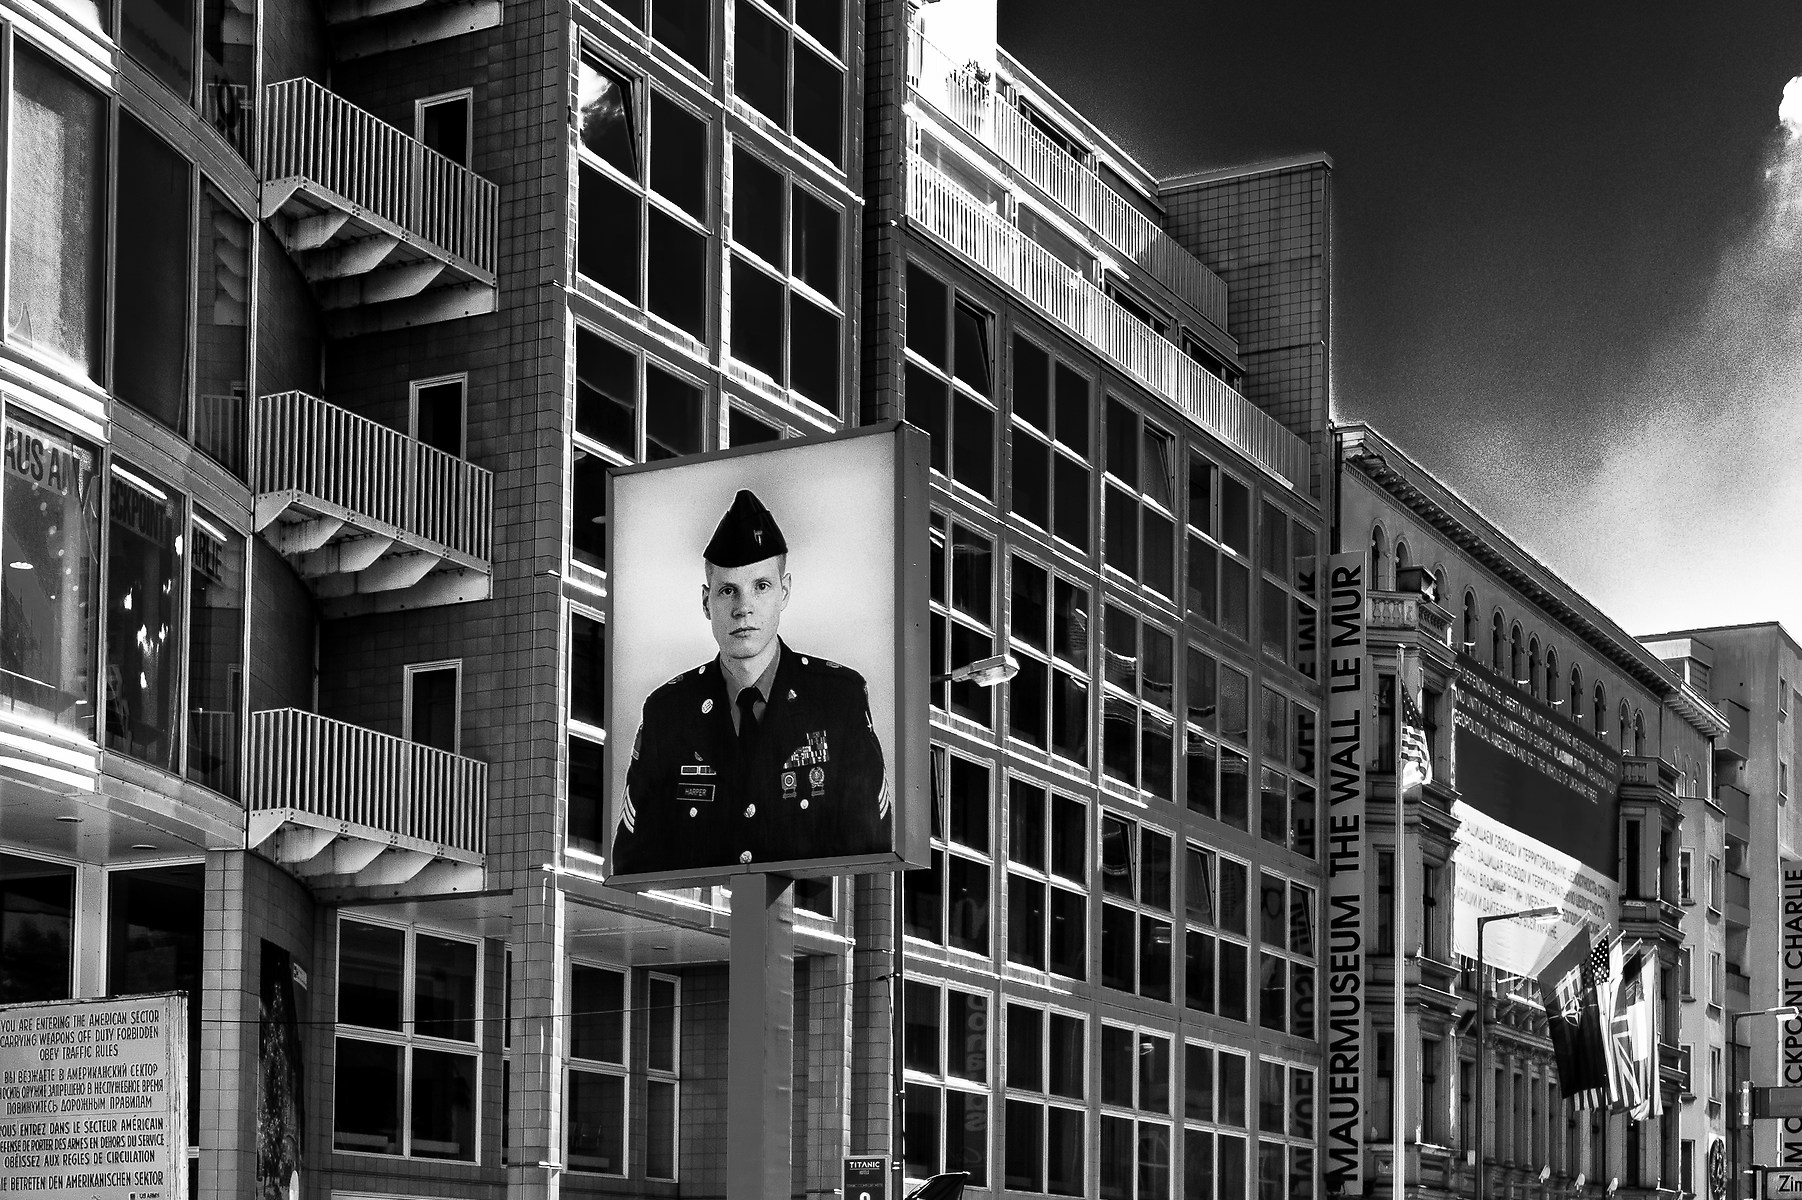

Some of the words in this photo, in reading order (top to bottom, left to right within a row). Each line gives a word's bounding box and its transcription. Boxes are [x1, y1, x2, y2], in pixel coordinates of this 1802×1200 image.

[1331, 565, 1362, 648] MUR
[1331, 657, 1361, 693] LE
[1330, 709, 1361, 806] WALL
[1330, 814, 1360, 877] THE
[1, 1019, 15, 1033] YOU
[19, 1018, 33, 1031] ARE
[36, 1015, 70, 1030] ENTERING
[73, 1014, 85, 1027] THE
[89, 1011, 127, 1027] AMERICAN
[131, 1009, 159, 1024] SECTOR
[0, 1033, 36, 1048] CARRYING
[39, 1031, 74, 1045] WEAPONS
[78, 1030, 91, 1043] OFF
[96, 1028, 114, 1042] DUTY
[117, 1026, 158, 1040] FORBIDDEN
[1329, 894, 1361, 1181] MAUERMUSEUM
[40, 1048, 59, 1061] OBEY
[63, 1046, 92, 1059] TRAFFIC
[96, 1044, 118, 1057] RULES
[4, 1071, 16, 1084] ВЫ
[59, 1068, 64, 1081] В
[67, 1063, 127, 1080] АМЕРИКАНСКИЙ
[131, 1063, 158, 1077] СЕКТОР
[88, 1081, 92, 1094] В
[143, 1079, 163, 1092] ВРЕМЯ
[110, 1096, 152, 1109] ПРАВИЛАМ
[20, 1123, 46, 1136] ENTREZ
[50, 1122, 70, 1135] DANS
[73, 1121, 80, 1133] LE
[84, 1119, 117, 1133] SECTEUR
[121, 1115, 163, 1131] AMÉRICAIN
[23, 1140, 30, 1152] DE
[31, 1139, 53, 1151] PORTER
[55, 1138, 66, 1150] DES
[67, 1137, 88, 1149] ARMES
[90, 1137, 98, 1148] EN
[100, 1135, 125, 1148] DEHORS
[127, 1135, 137, 1147] DU
[138, 1133, 165, 1146] SERVICE
[4, 1152, 40, 1168] OBÉISSEZ
[44, 1154, 60, 1167] AUX
[63, 1153, 89, 1166] REGLES
[94, 1152, 102, 1164] DE
[106, 1150, 155, 1163] CIRCULATION
[849, 1161, 880, 1169] TITANIC
[11, 1175, 46, 1190] BETRETEN
[49, 1175, 63, 1189] DEN
[66, 1172, 131, 1188] AMERIKANISCHEN
[135, 1170, 163, 1185] SEKTOR
